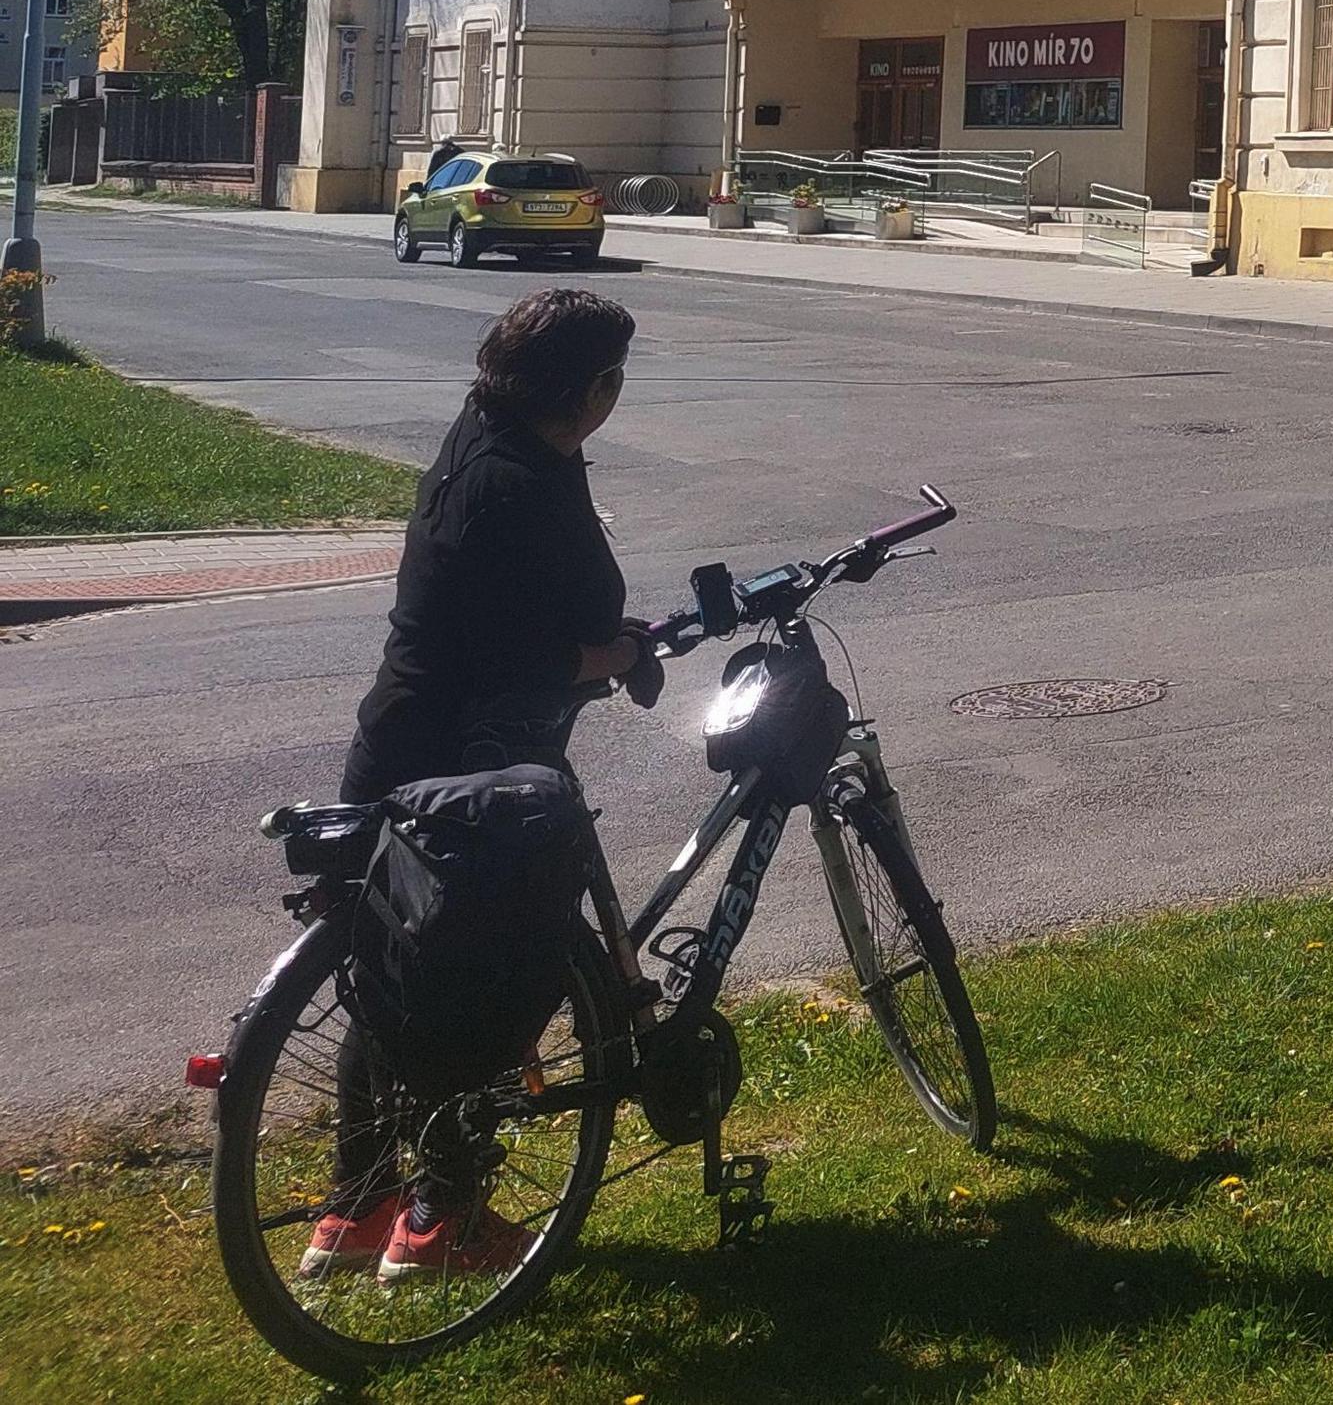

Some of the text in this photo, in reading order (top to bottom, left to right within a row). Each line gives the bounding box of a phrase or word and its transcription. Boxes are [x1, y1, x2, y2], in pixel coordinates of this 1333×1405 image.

[988, 32, 1095, 68] KINO MÍR 70
[707, 802, 784, 971] MAXBI
